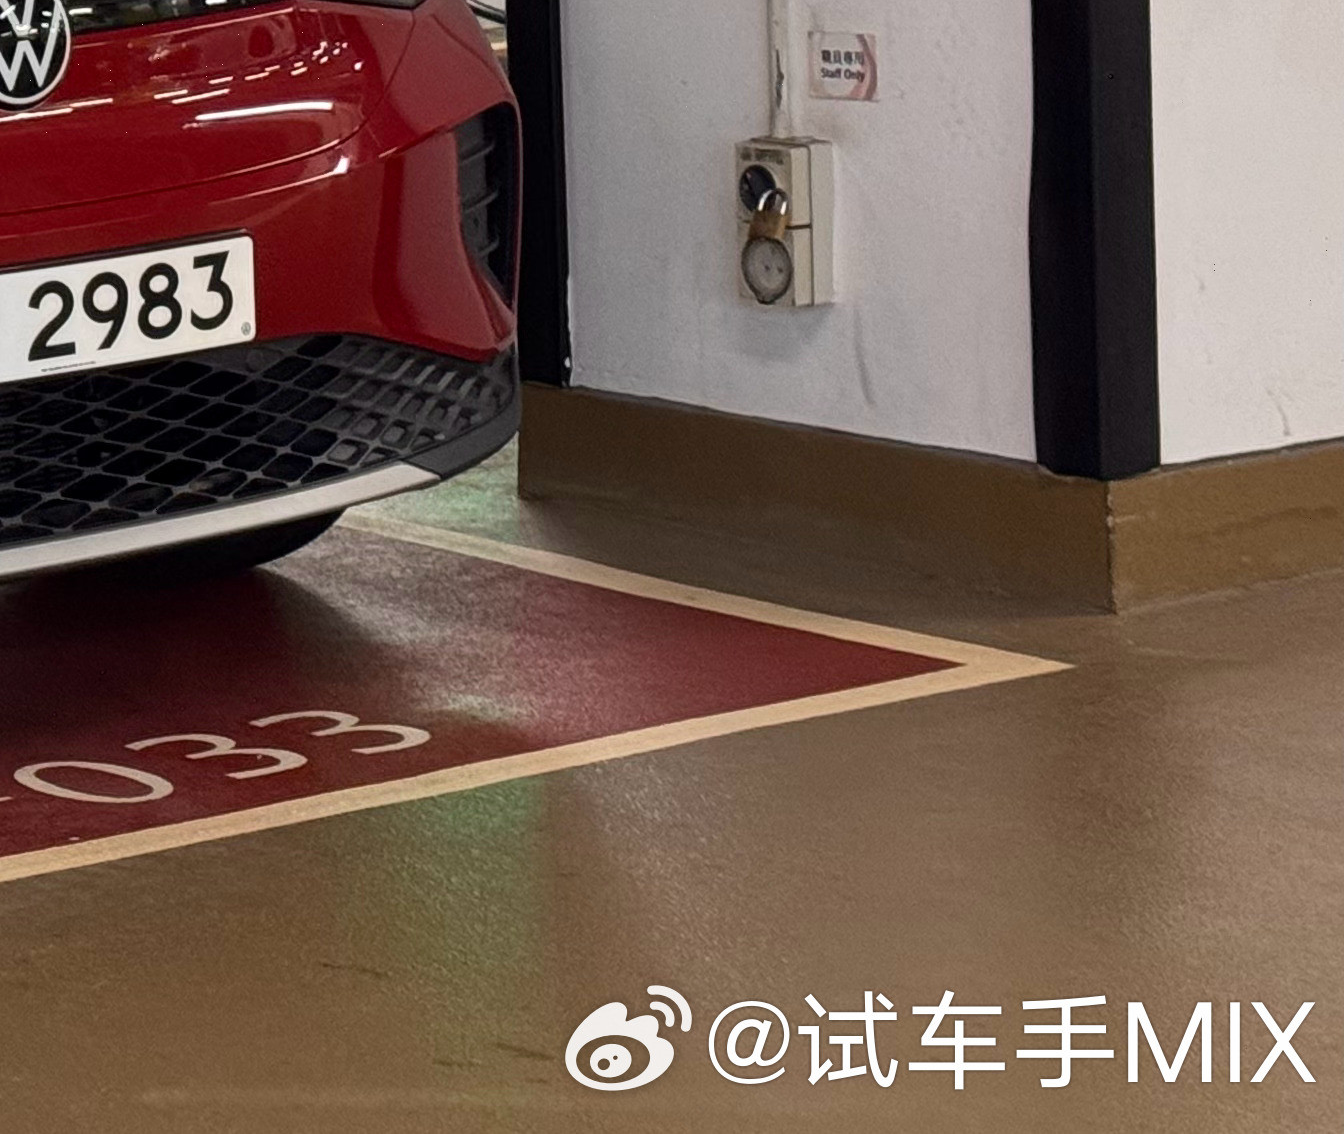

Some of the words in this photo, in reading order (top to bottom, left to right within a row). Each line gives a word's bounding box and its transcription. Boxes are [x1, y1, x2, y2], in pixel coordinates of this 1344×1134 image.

[821, 67, 842, 78] Staff
[843, 68, 865, 83] Only
[27, 250, 234, 363] 2983
